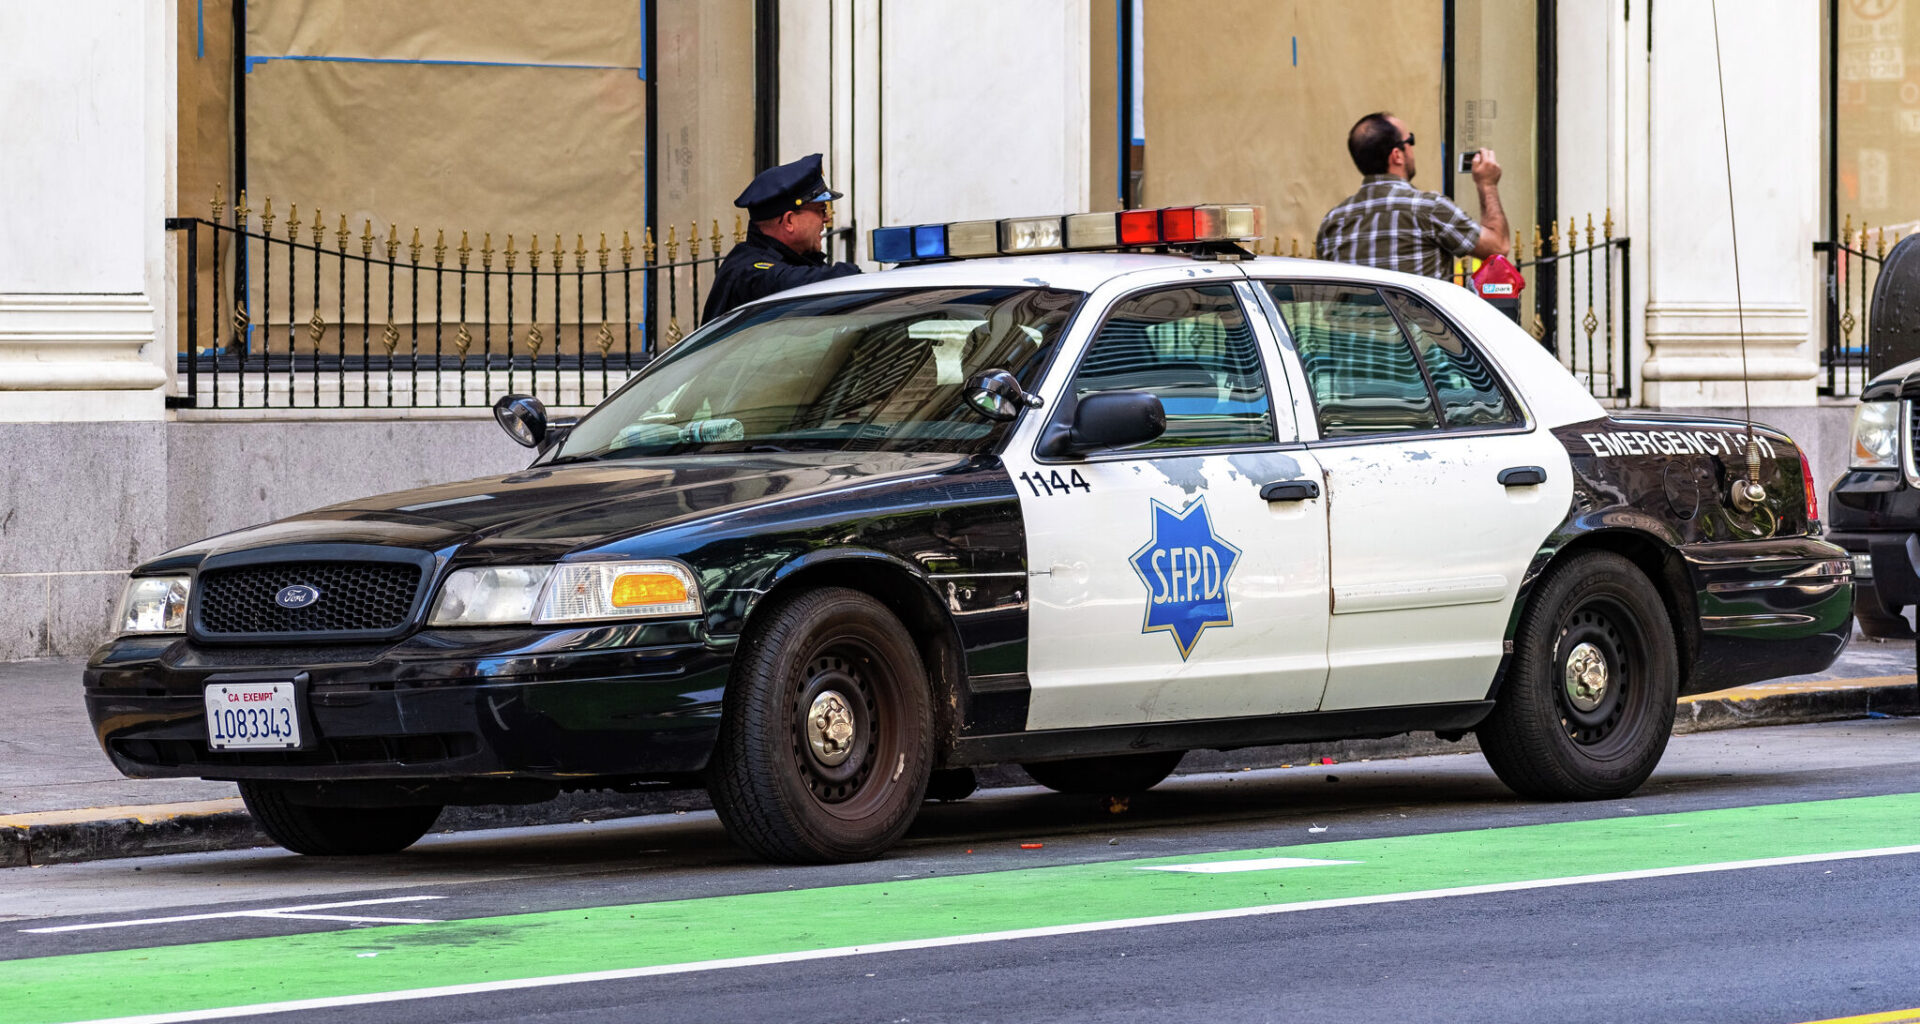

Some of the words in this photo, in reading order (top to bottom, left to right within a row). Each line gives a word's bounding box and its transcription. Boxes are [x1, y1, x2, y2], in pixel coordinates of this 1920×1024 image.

[1019, 468, 1091, 497] 1144
[1151, 545, 1222, 605] S.F.P.D.
[284, 589, 307, 603] Ford
[228, 693, 239, 702] CA
[243, 692, 273, 702] EXEMPT
[214, 708, 292, 739] 1083343
